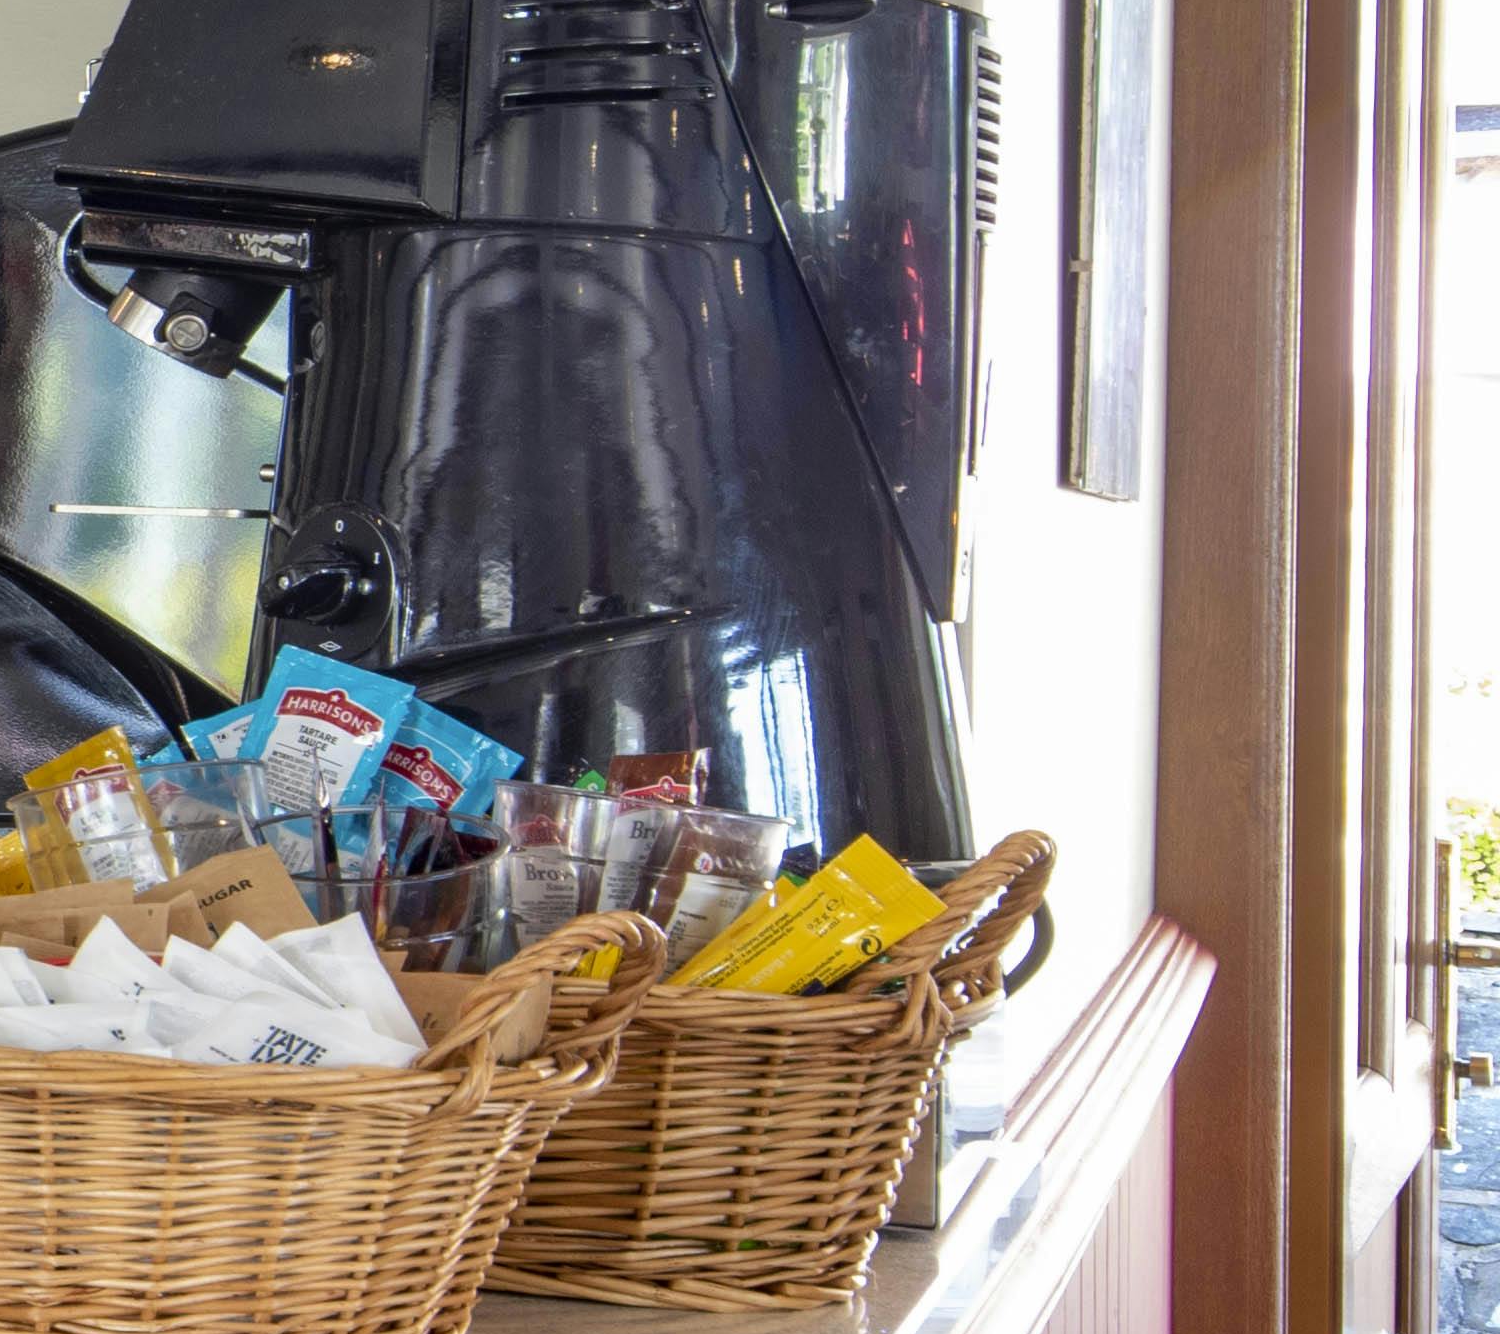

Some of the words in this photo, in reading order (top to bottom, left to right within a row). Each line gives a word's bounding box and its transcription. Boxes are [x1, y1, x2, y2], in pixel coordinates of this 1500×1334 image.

[287, 697, 373, 736] HARRISONS
[298, 736, 328, 752] SAUCE
[300, 725, 339, 745] TARTARE
